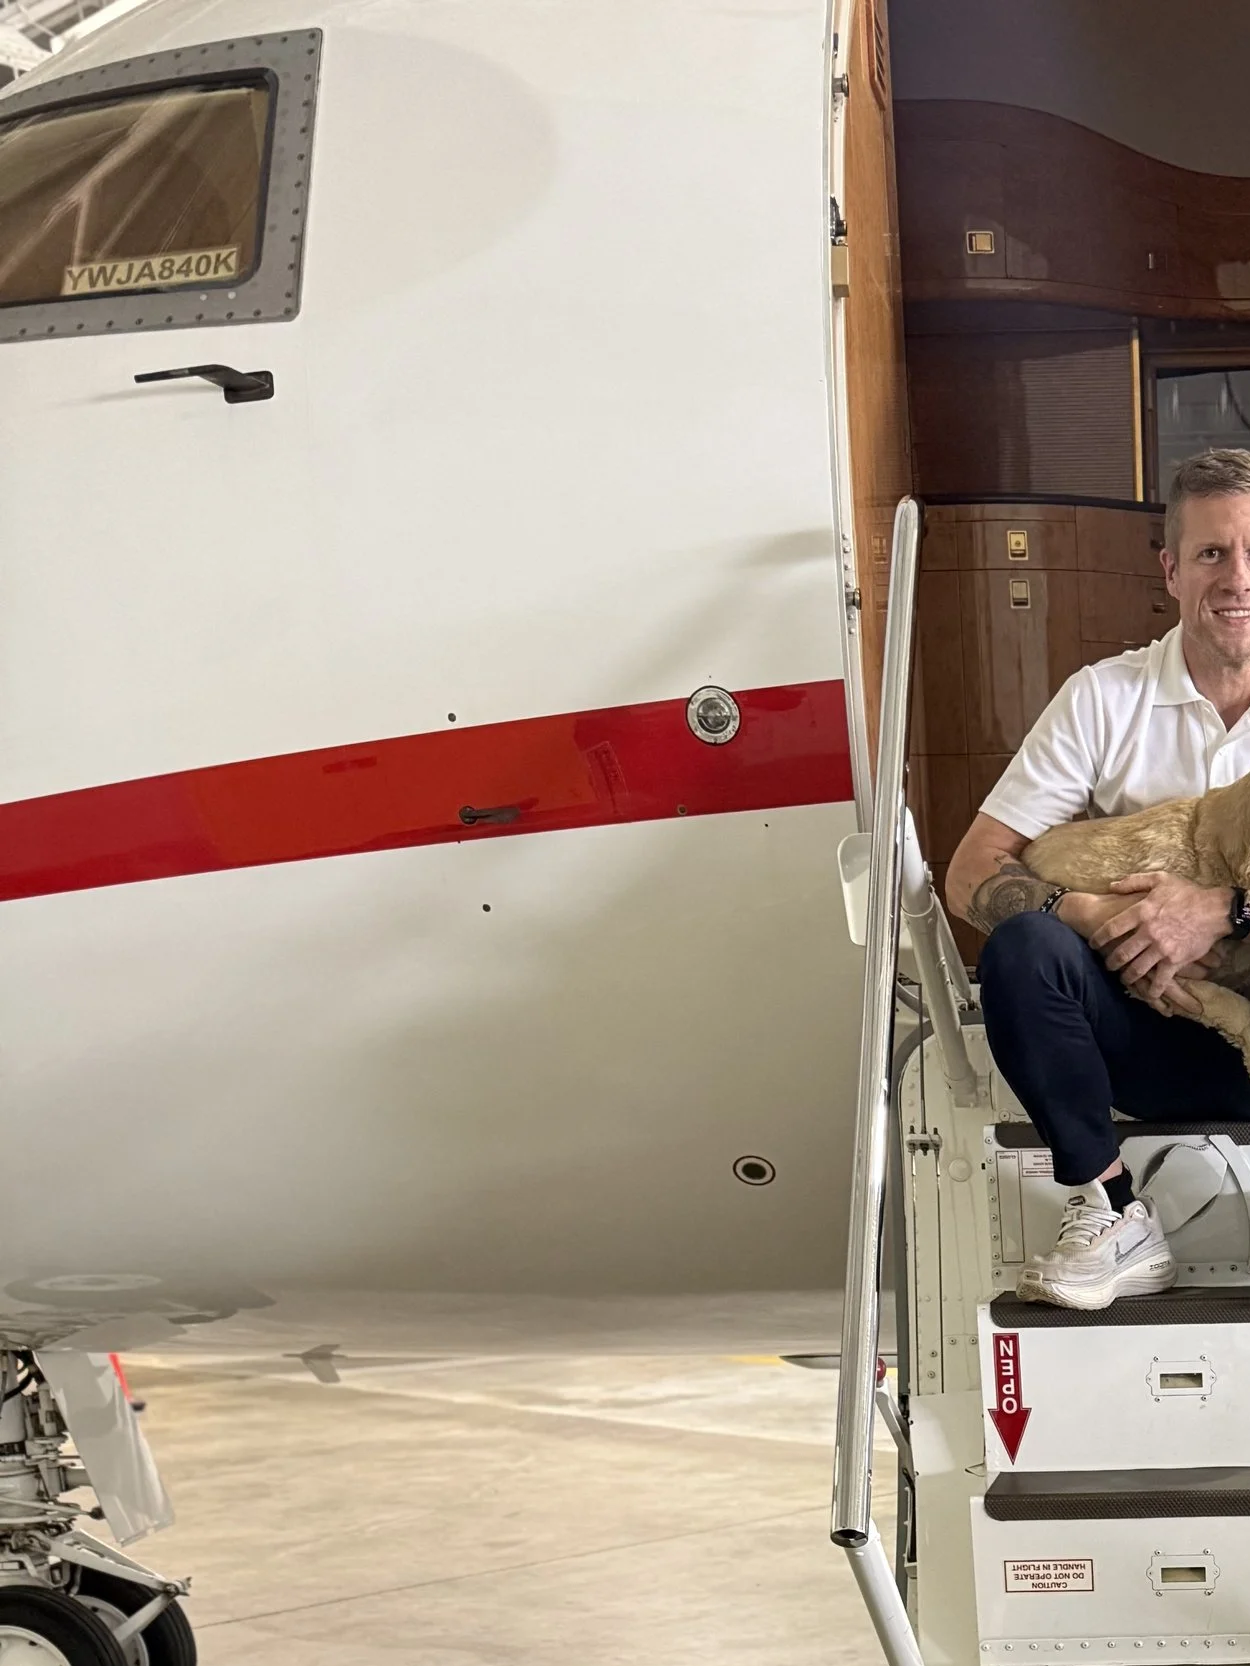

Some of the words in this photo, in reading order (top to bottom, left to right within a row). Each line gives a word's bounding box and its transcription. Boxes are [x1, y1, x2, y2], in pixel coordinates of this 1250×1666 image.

[65, 250, 237, 291] YWJA840K
[999, 1339, 1018, 1415] OPEN
[1031, 1581, 1068, 1589] CAUTION
